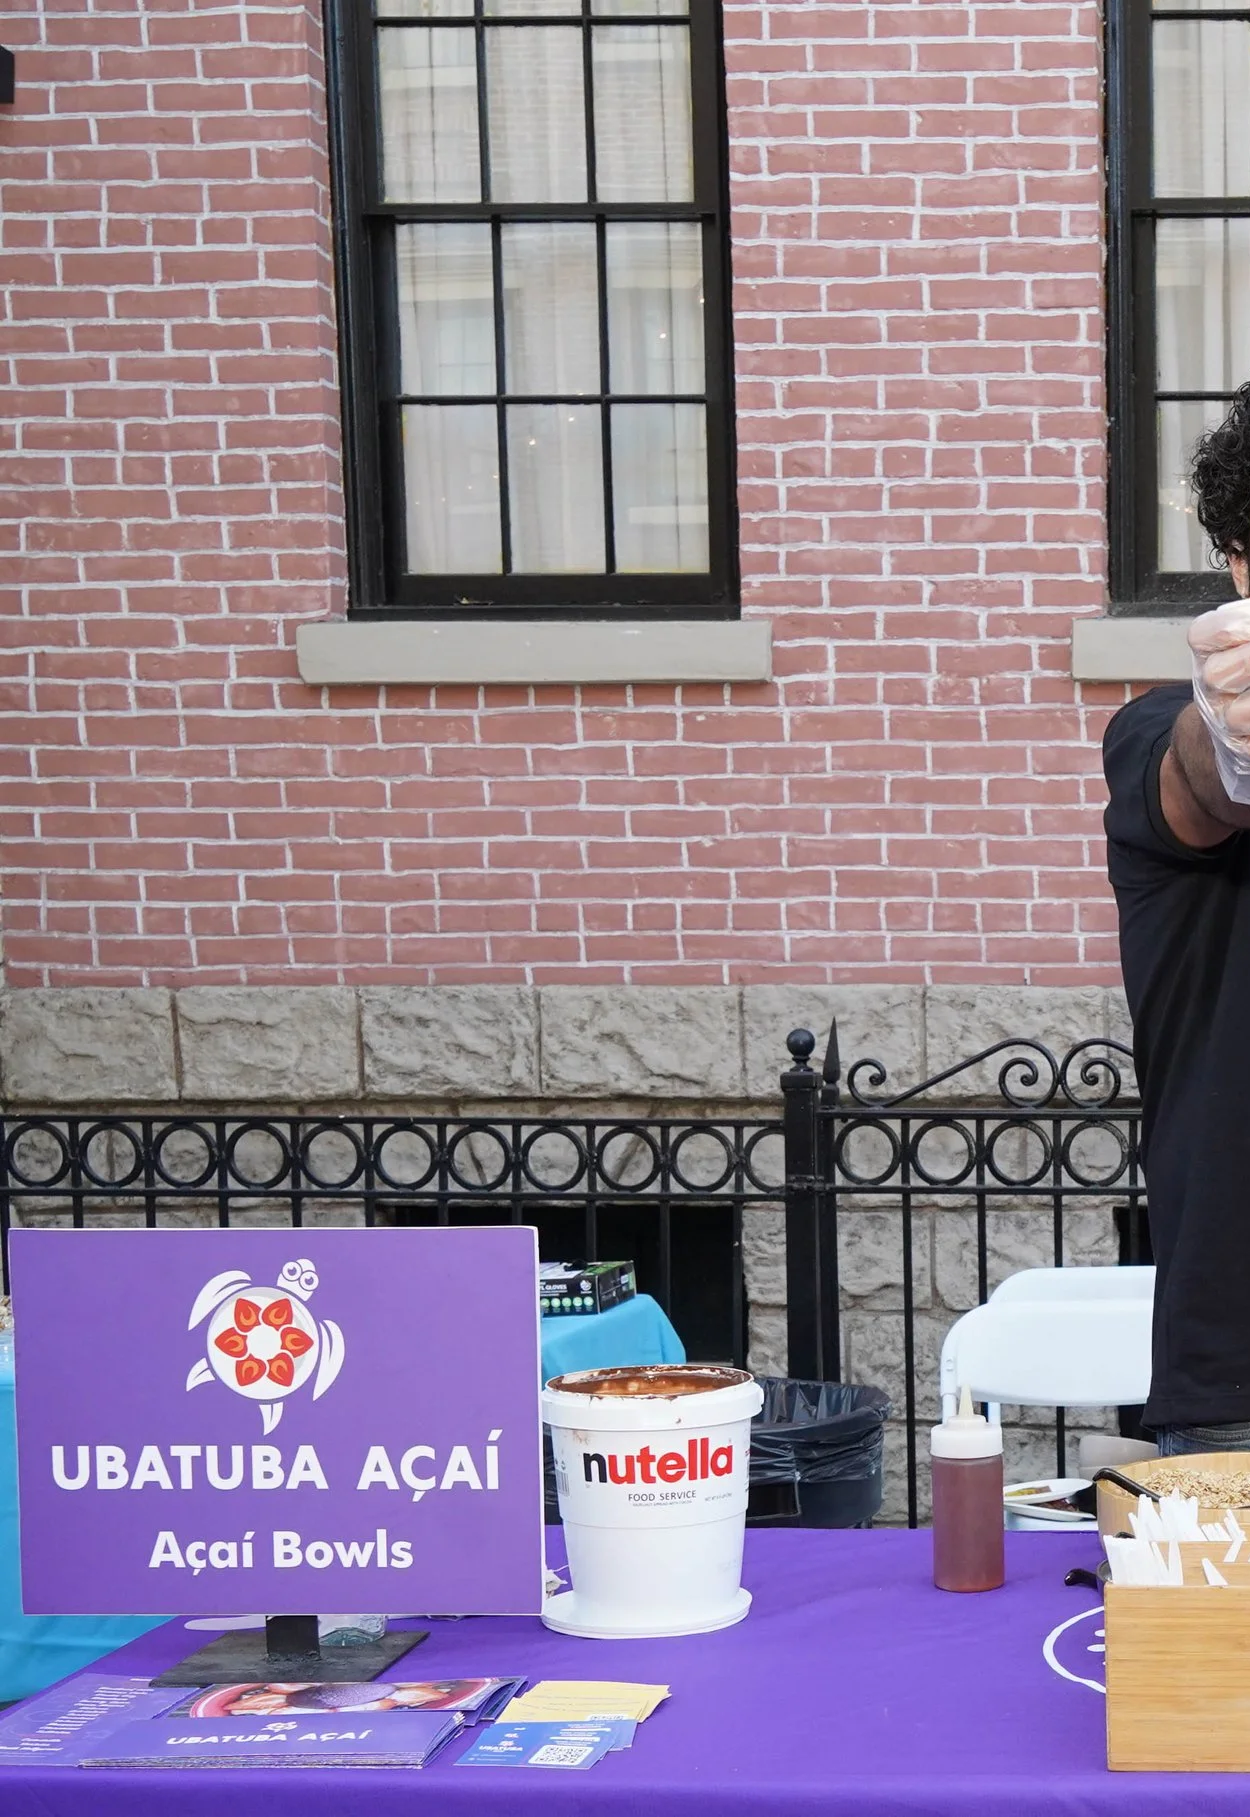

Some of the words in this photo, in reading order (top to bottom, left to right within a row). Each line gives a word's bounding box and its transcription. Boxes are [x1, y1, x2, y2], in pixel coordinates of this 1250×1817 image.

[51, 1445, 329, 1491] UBATUBA
[356, 1429, 503, 1502] AÇAÍ
[583, 1437, 734, 1485] nutella
[628, 1493, 656, 1502] FOOD
[659, 1489, 697, 1501] SERVICE
[148, 1531, 256, 1576] Açaí
[272, 1528, 414, 1570] Bowls
[166, 1733, 287, 1745] UBATUBA
[297, 1729, 373, 1742] AÇAÍ
